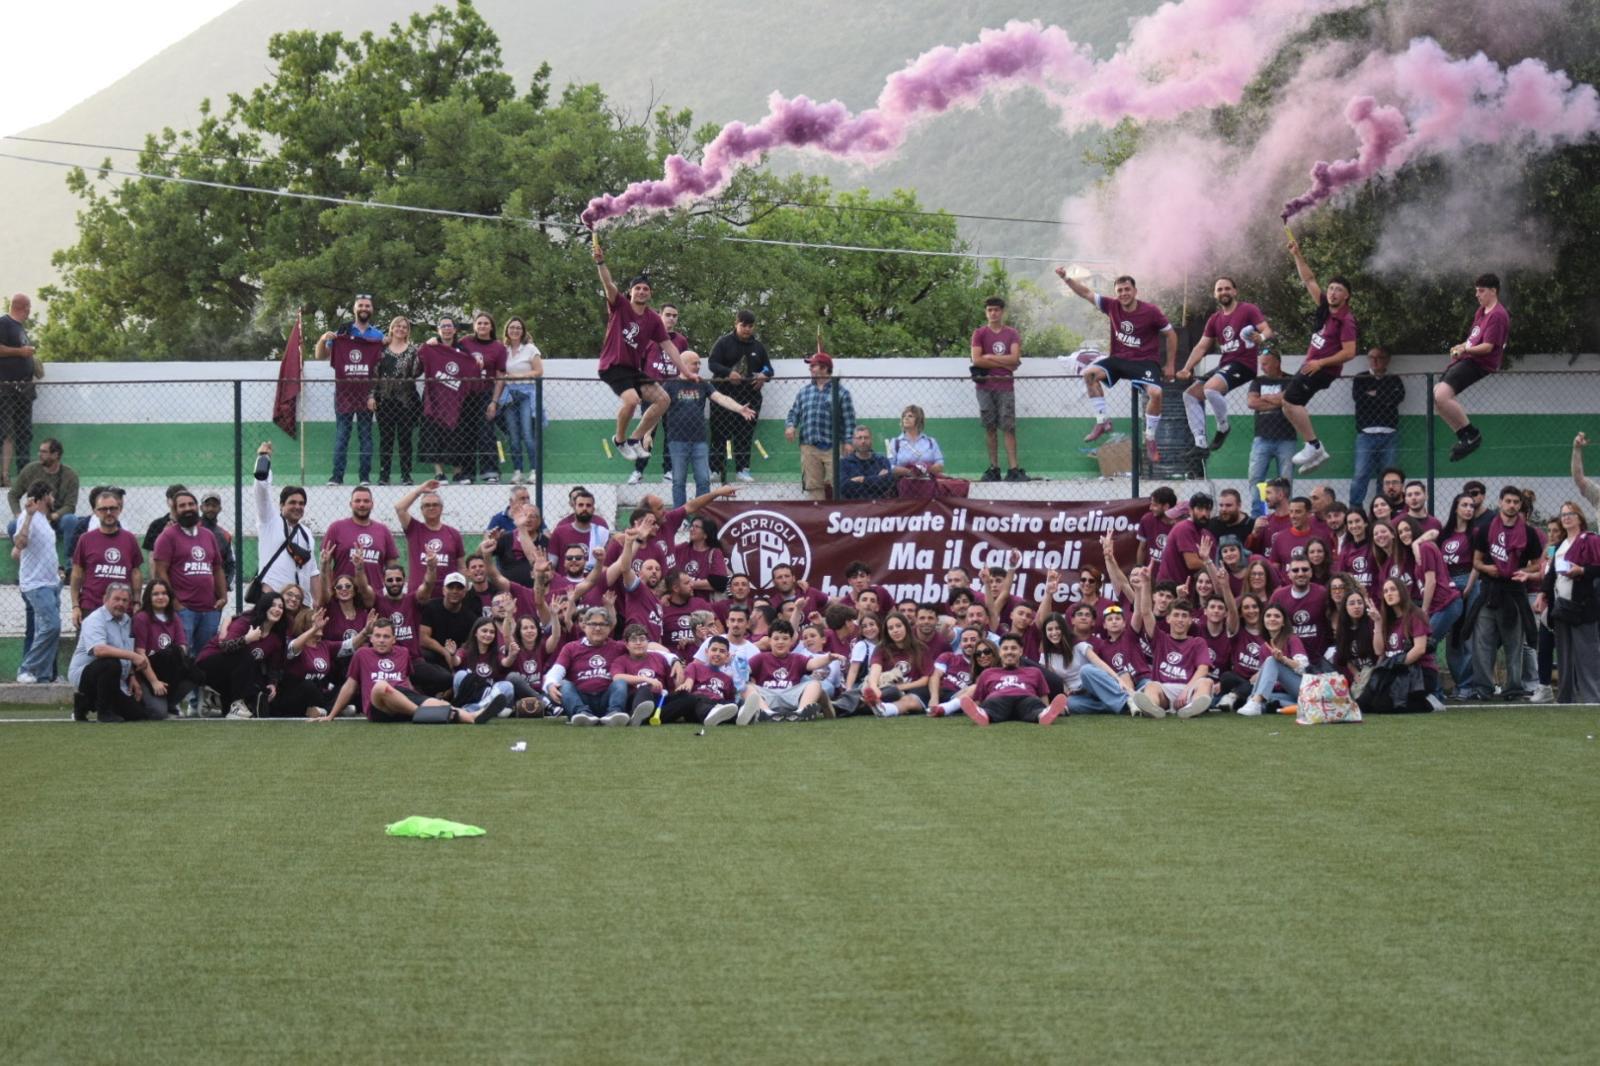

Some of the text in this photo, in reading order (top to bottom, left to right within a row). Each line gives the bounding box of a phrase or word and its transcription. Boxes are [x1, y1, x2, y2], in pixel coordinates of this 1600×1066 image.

[344, 364, 369, 372] PRIMA
[1145, 370, 1152, 378] 9
[827, 511, 944, 537] Sognavate
[951, 508, 967, 531] il
[972, 512, 1043, 533] nostro
[730, 518, 796, 543] CAPRIOLI
[350, 548, 380, 560] PIMA
[888, 540, 1082, 570] Ma il Caprioli
[184, 562, 213, 571] PRIMA
[792, 557, 806, 566] 74
[95, 564, 127, 576] PRIMA
